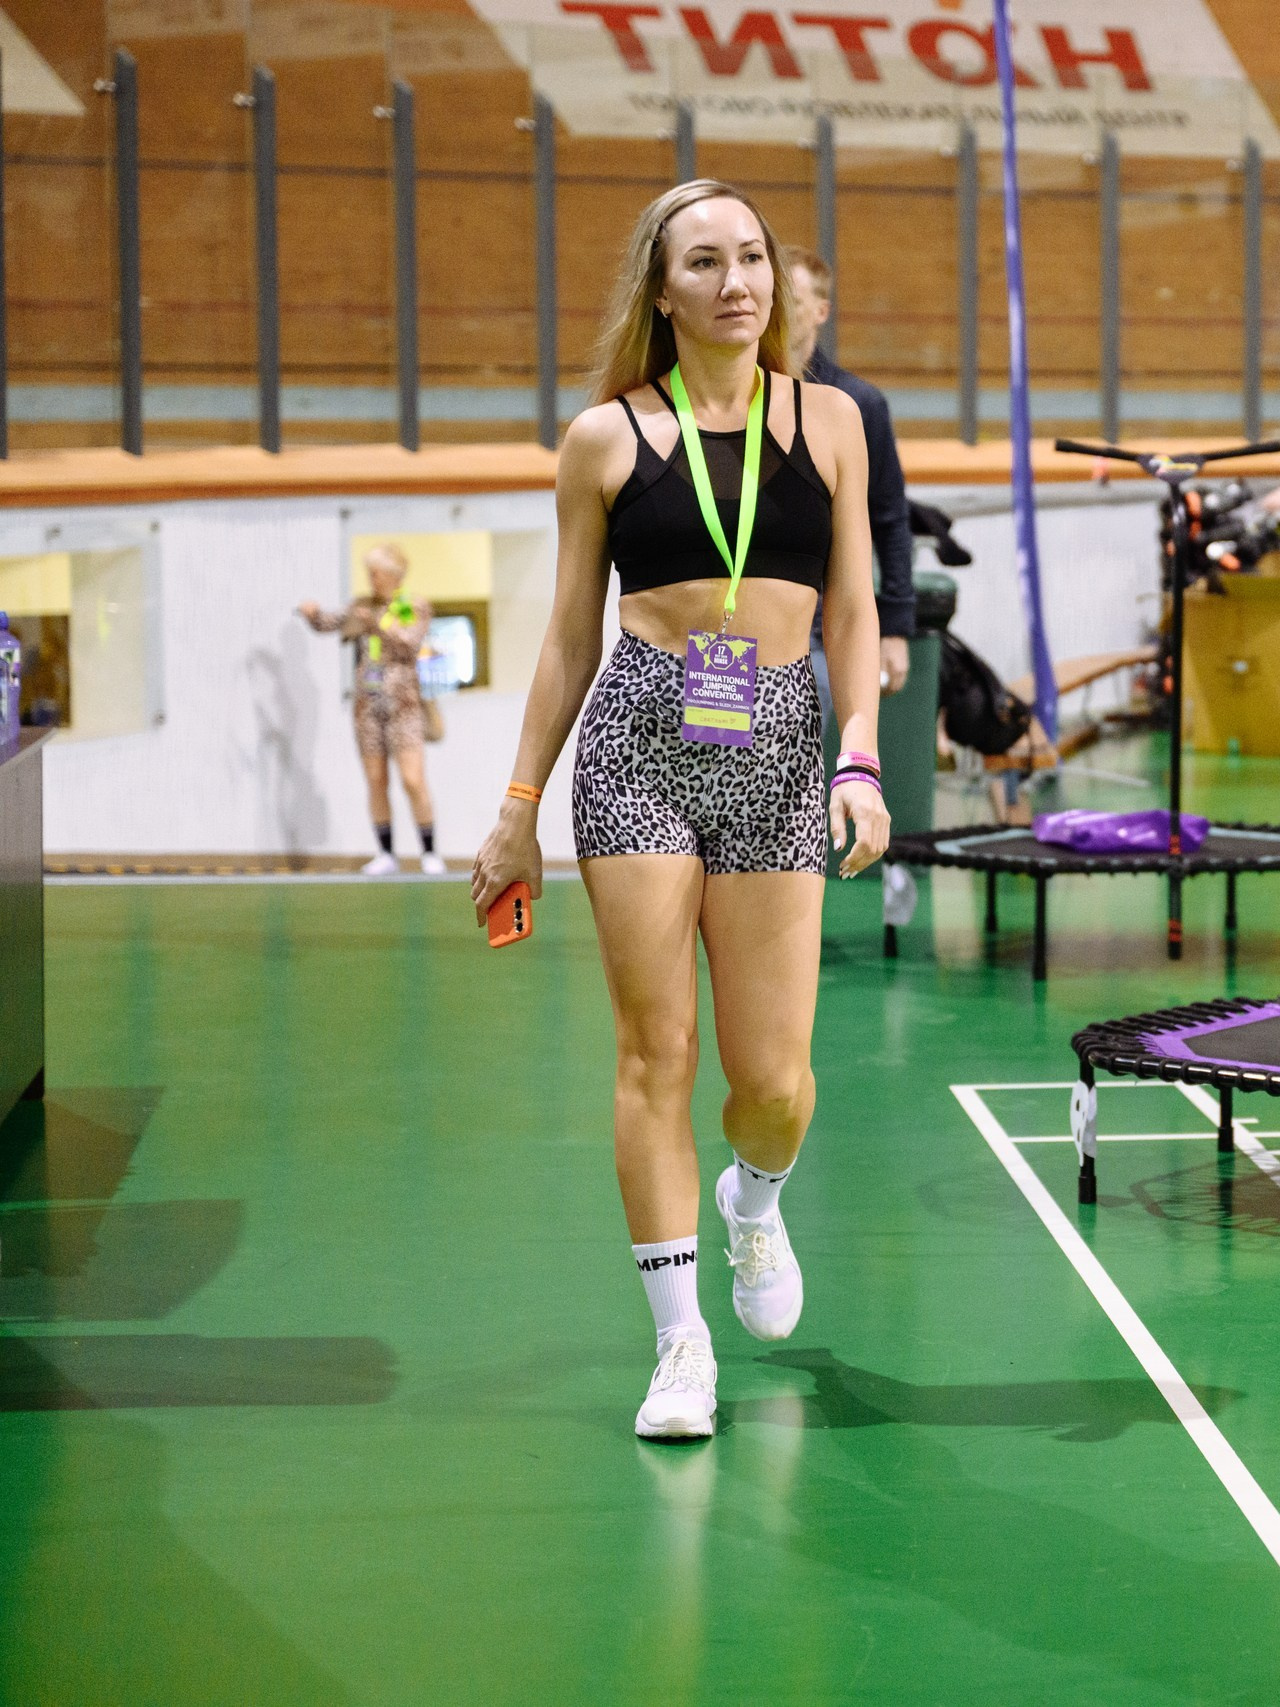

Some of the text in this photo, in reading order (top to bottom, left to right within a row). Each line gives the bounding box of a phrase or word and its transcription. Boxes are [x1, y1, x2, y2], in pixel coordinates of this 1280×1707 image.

[717, 645, 726, 655] 17
[689, 671, 750, 687] INTERNATIONAL
[692, 687, 744, 702] CONVENTION
[702, 681, 737, 693] JUMPING
[636, 1250, 698, 1272] MPIN
